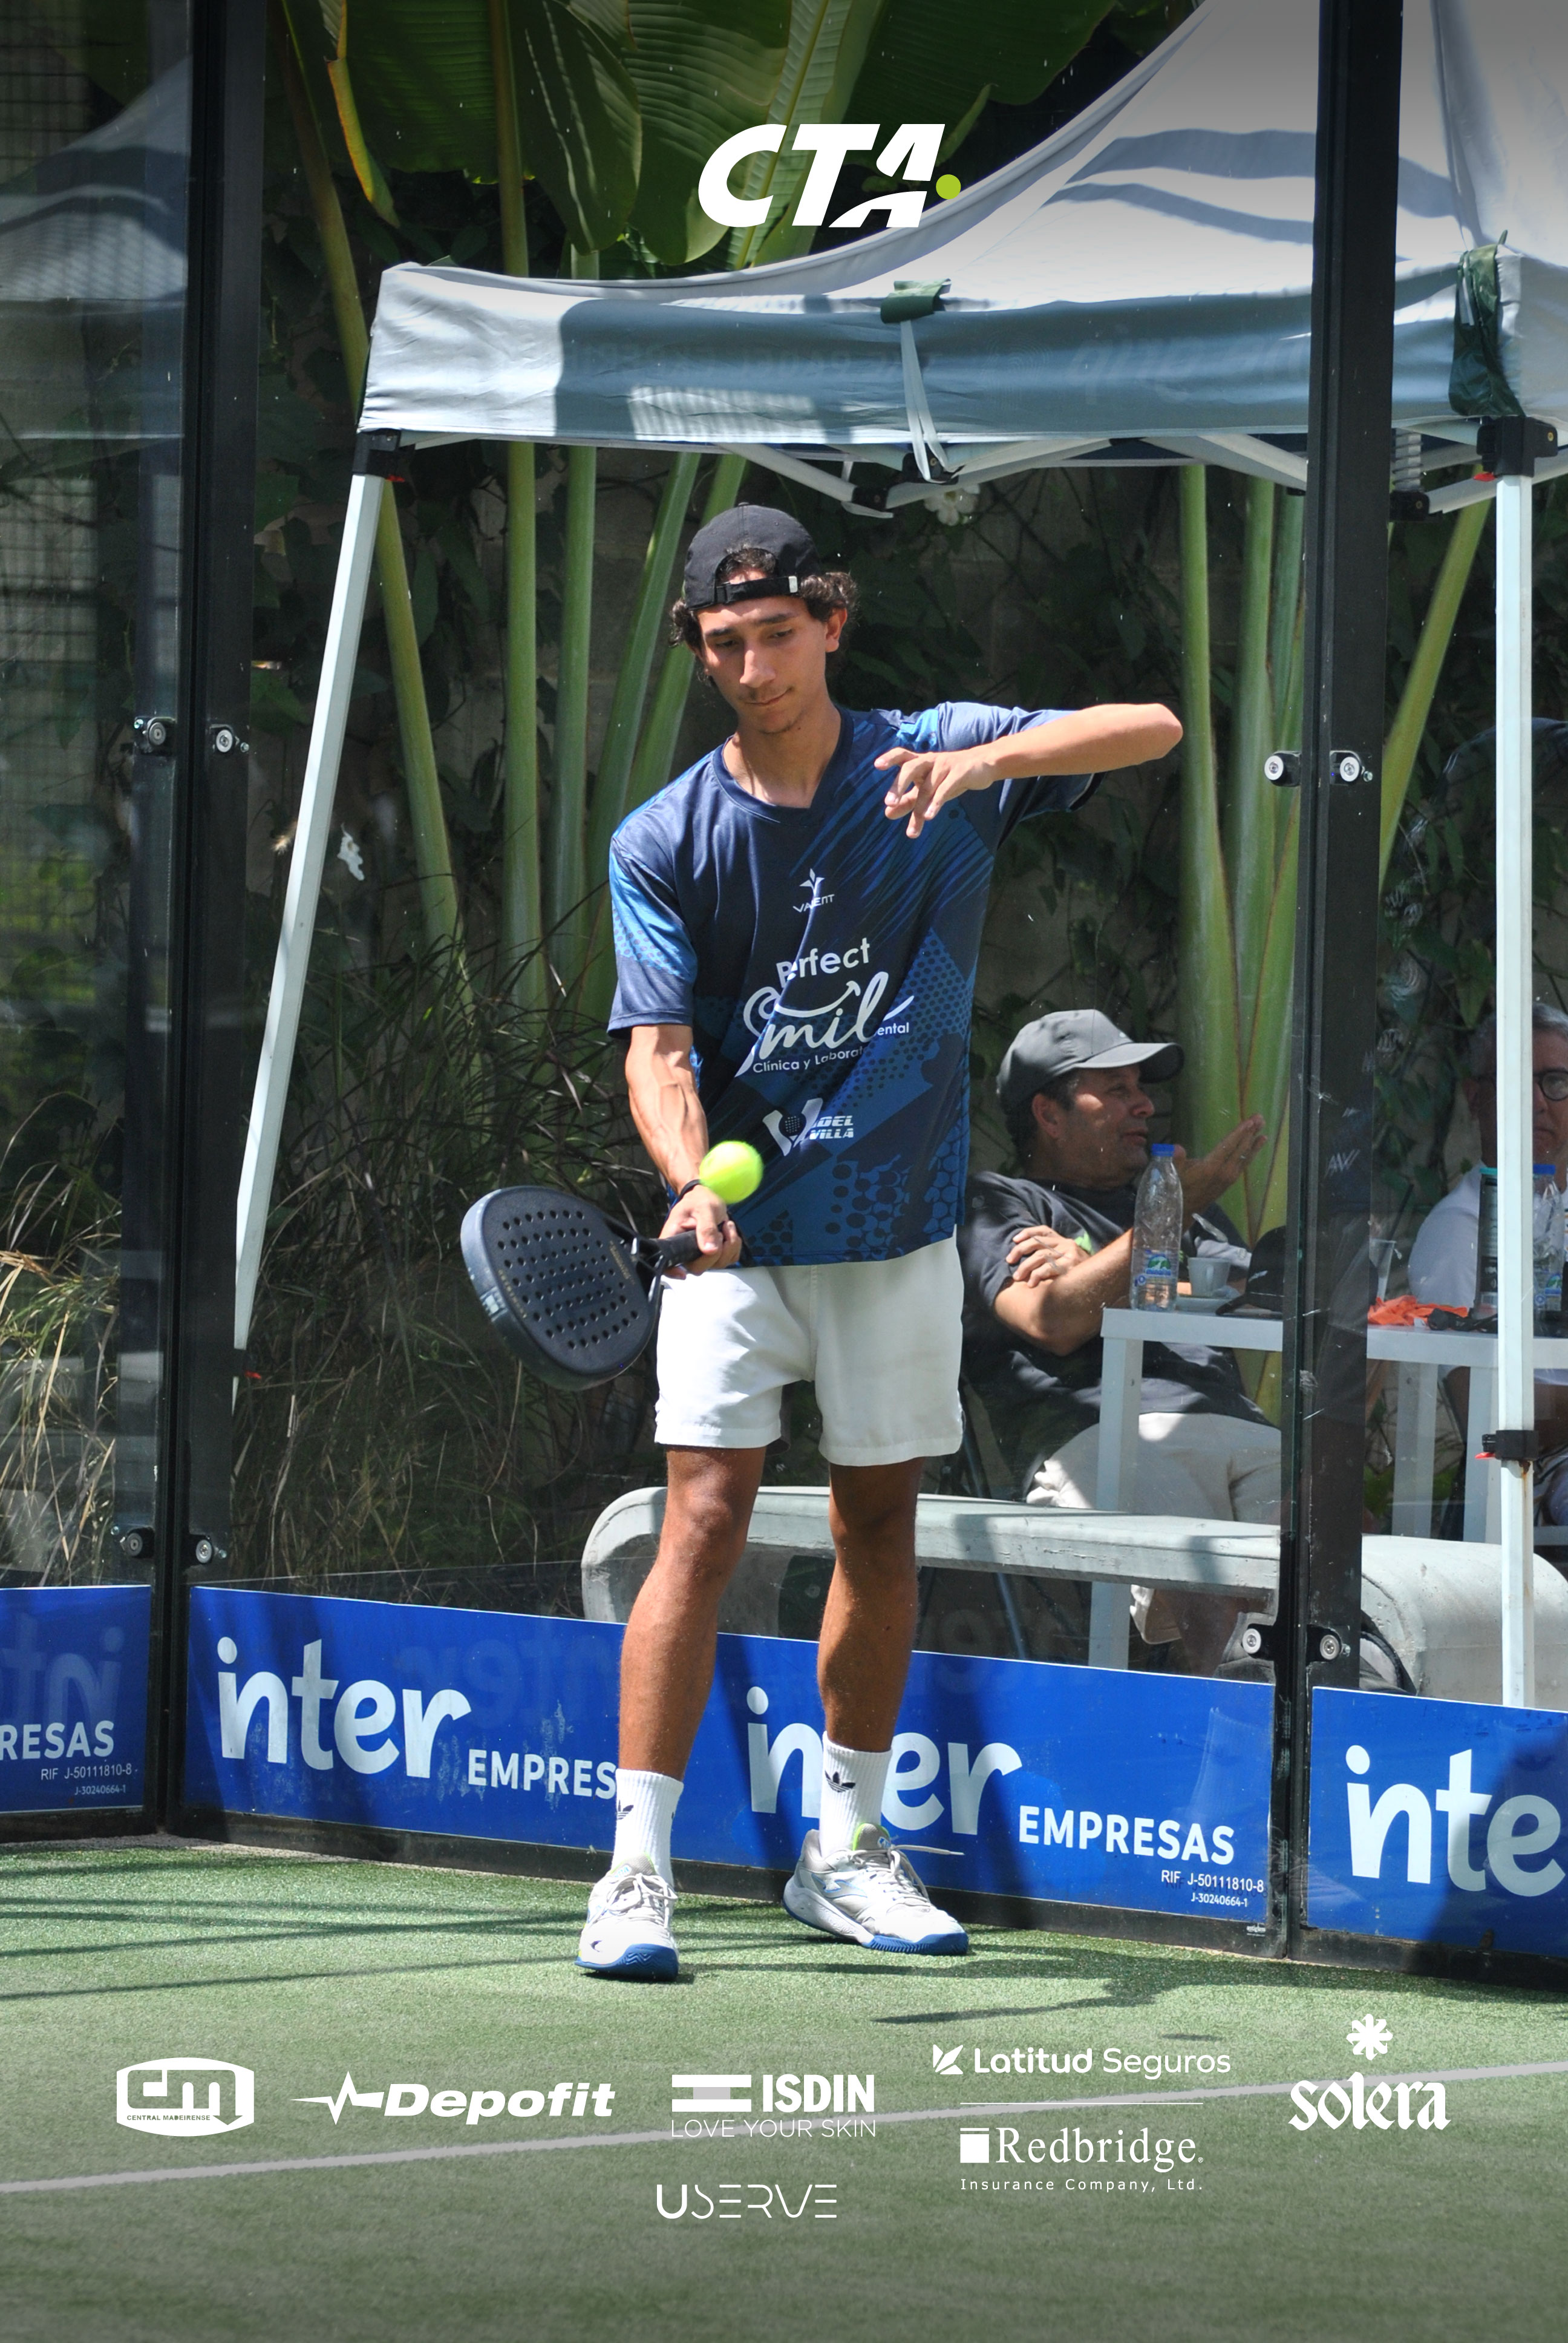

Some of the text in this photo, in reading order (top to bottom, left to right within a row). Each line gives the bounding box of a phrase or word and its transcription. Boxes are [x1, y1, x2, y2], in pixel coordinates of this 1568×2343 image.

[753, 1060, 800, 1073] Clínica
[803, 1059, 811, 1070] y
[809, 1128, 854, 1140] VILLA
[217, 1636, 471, 1778] inter
[41, 1763, 132, 1780] RIF J-50111810-8
[746, 1686, 1235, 1865] iner EMPRESAS
[1345, 1745, 1566, 1897] inte
[1161, 1870, 1264, 1893] RIF J-50111810-8
[1191, 1892, 1248, 1907] J-30240664-1
